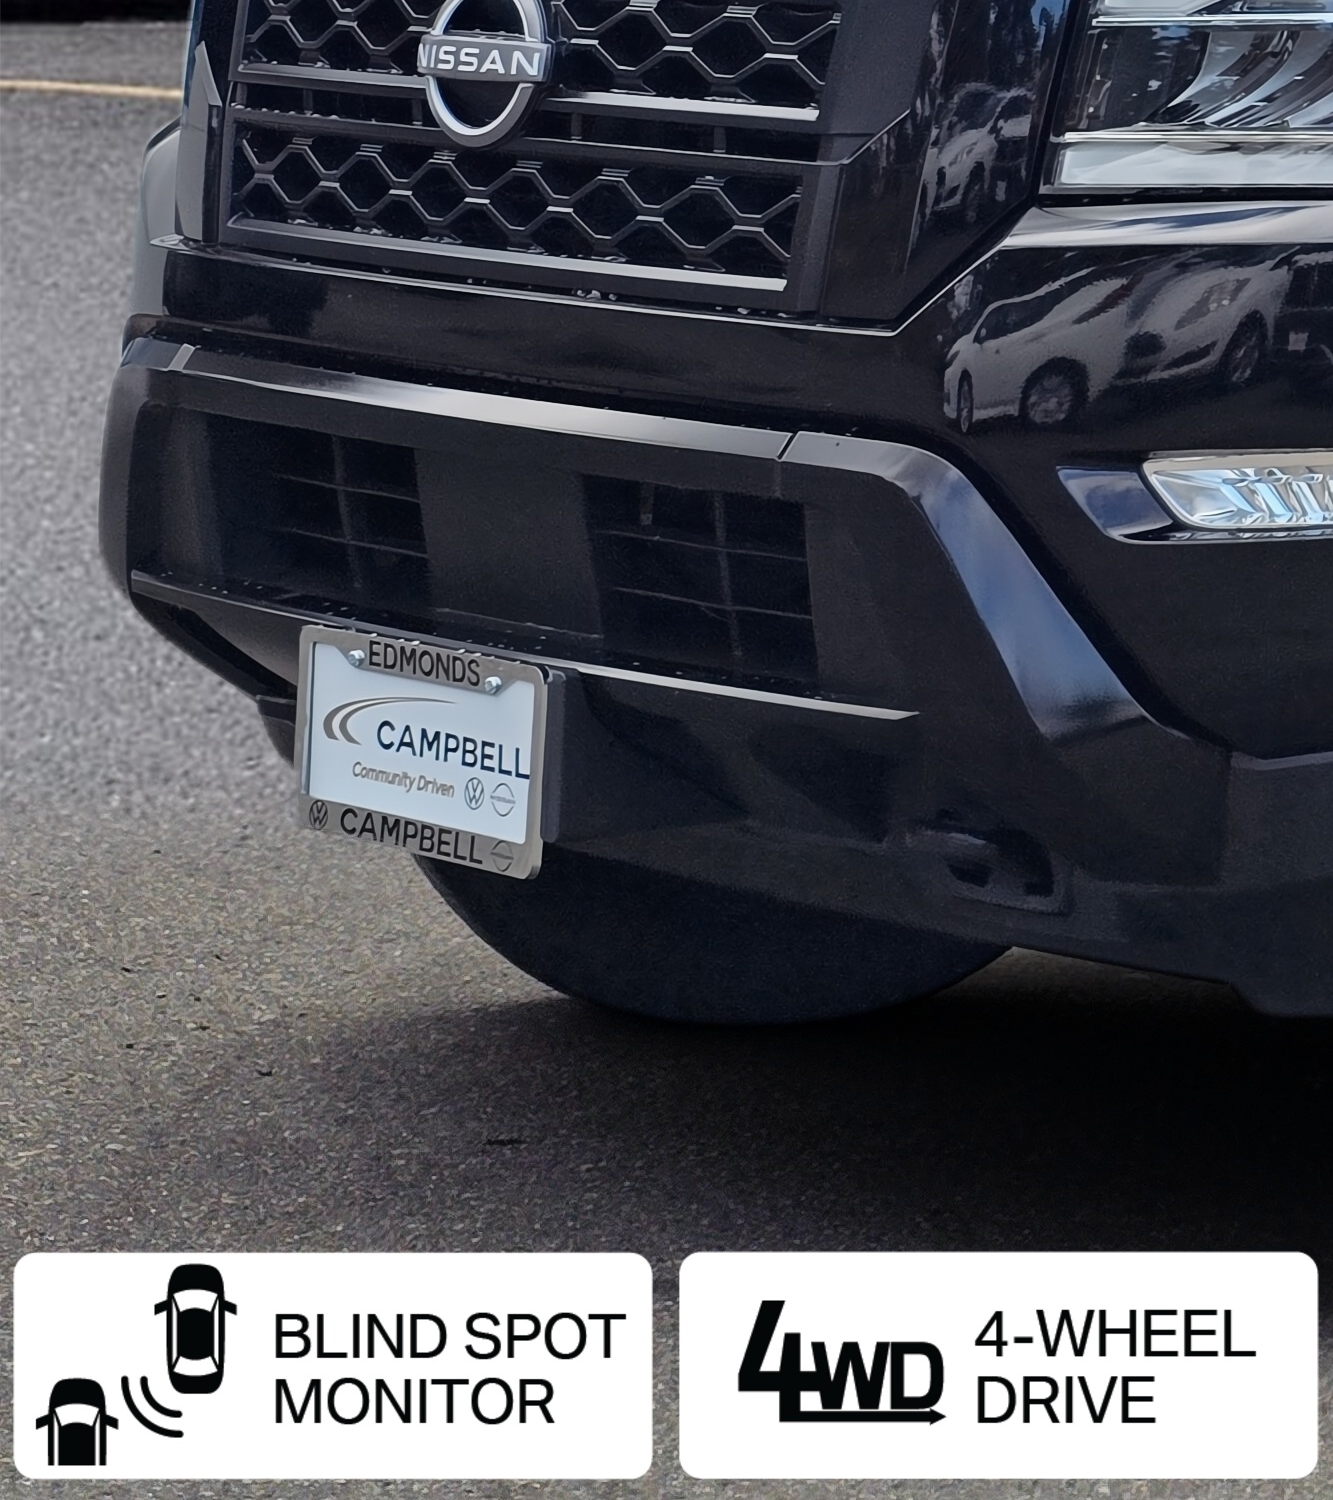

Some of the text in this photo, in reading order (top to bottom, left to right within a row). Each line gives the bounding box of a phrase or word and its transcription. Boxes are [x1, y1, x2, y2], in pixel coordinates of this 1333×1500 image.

[418, 43, 541, 76] NISSAN
[368, 640, 481, 687] EDMONDS
[376, 719, 530, 780] CAMPBELL
[352, 761, 455, 798] Community Driven
[340, 807, 483, 865] CAMPBELL
